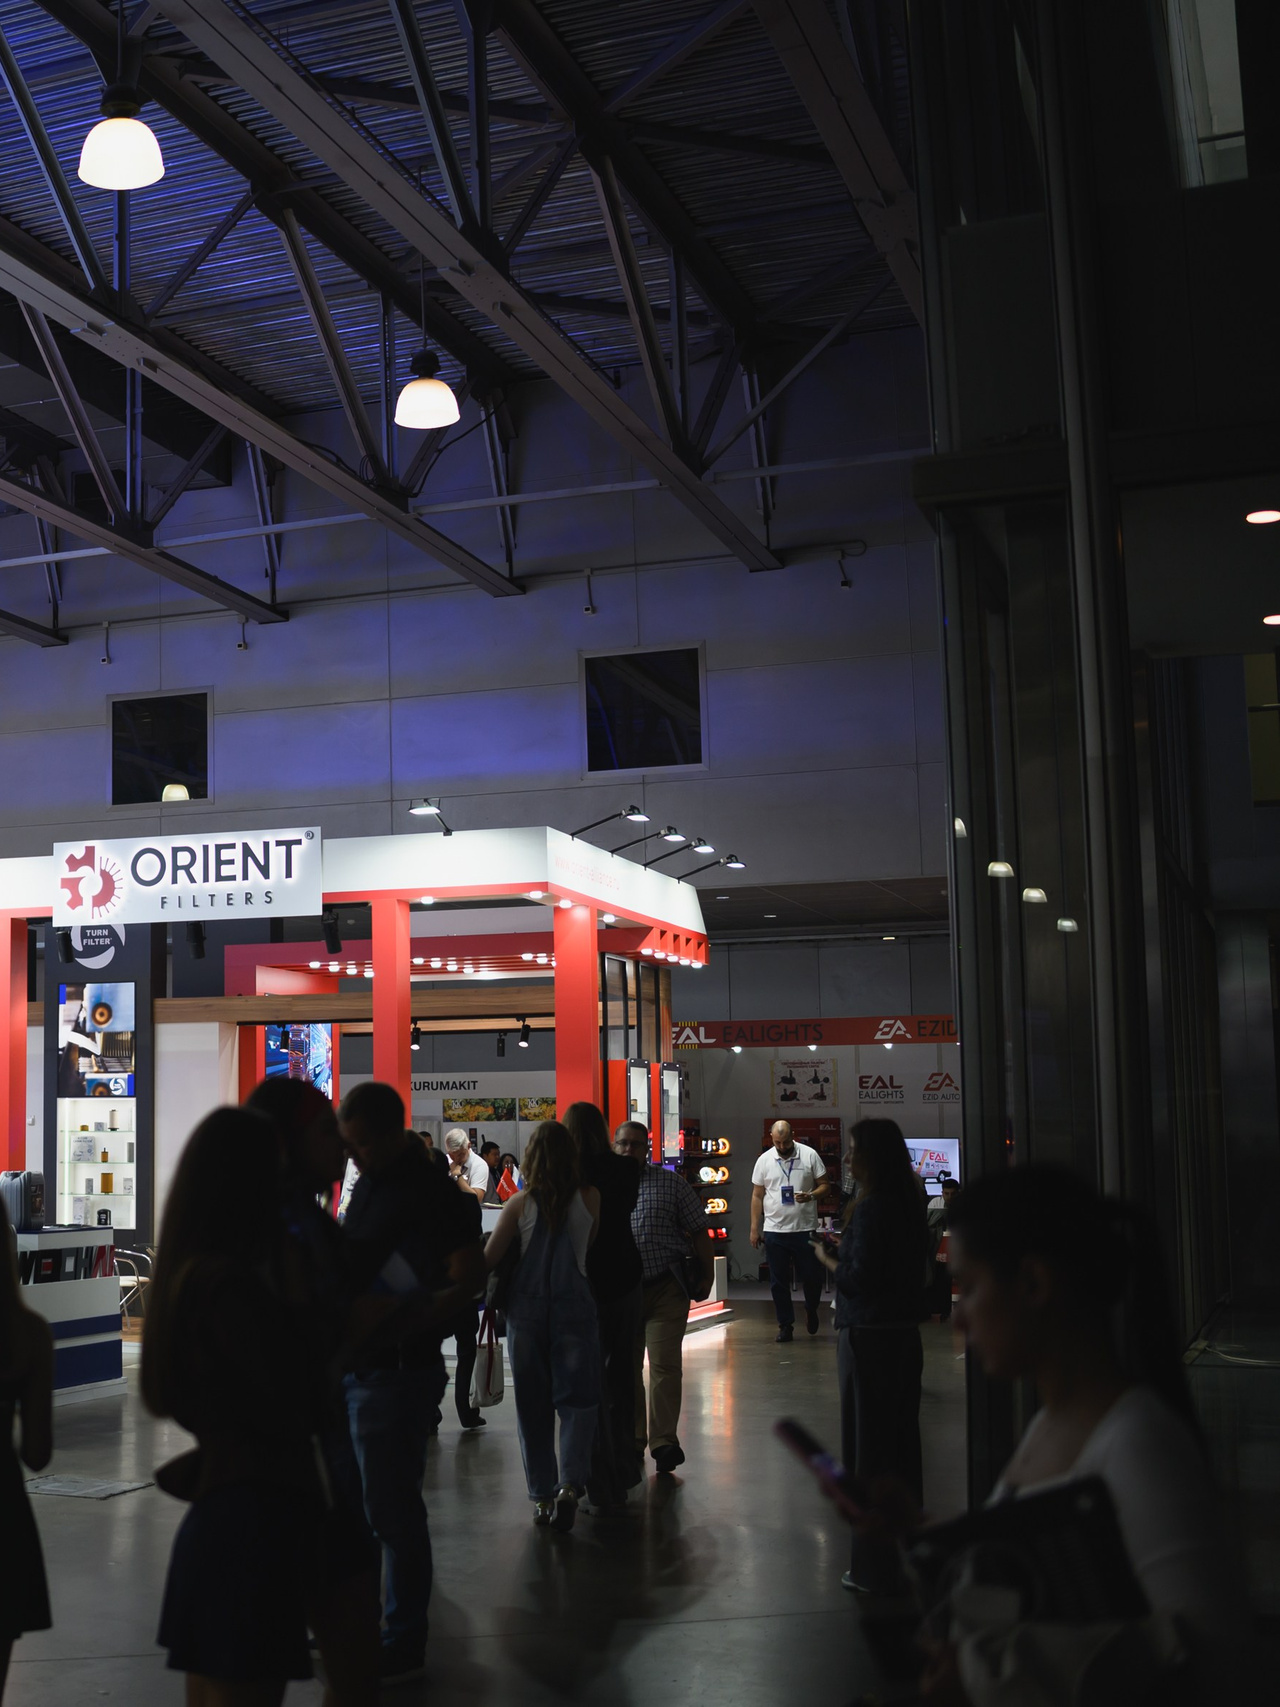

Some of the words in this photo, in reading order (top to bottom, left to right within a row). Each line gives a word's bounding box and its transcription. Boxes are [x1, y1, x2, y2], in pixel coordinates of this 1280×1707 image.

[131, 838, 303, 887] ORIENT
[160, 891, 274, 910] FILTERS
[85, 928, 109, 937] TURN
[722, 1023, 824, 1043] EALIGHTS
[858, 1075, 904, 1090] EAL
[858, 1090, 905, 1100] EALIGHTS
[922, 1093, 939, 1101] EZID
[940, 1092, 961, 1101] AUTO
[929, 1151, 948, 1162] EAL
